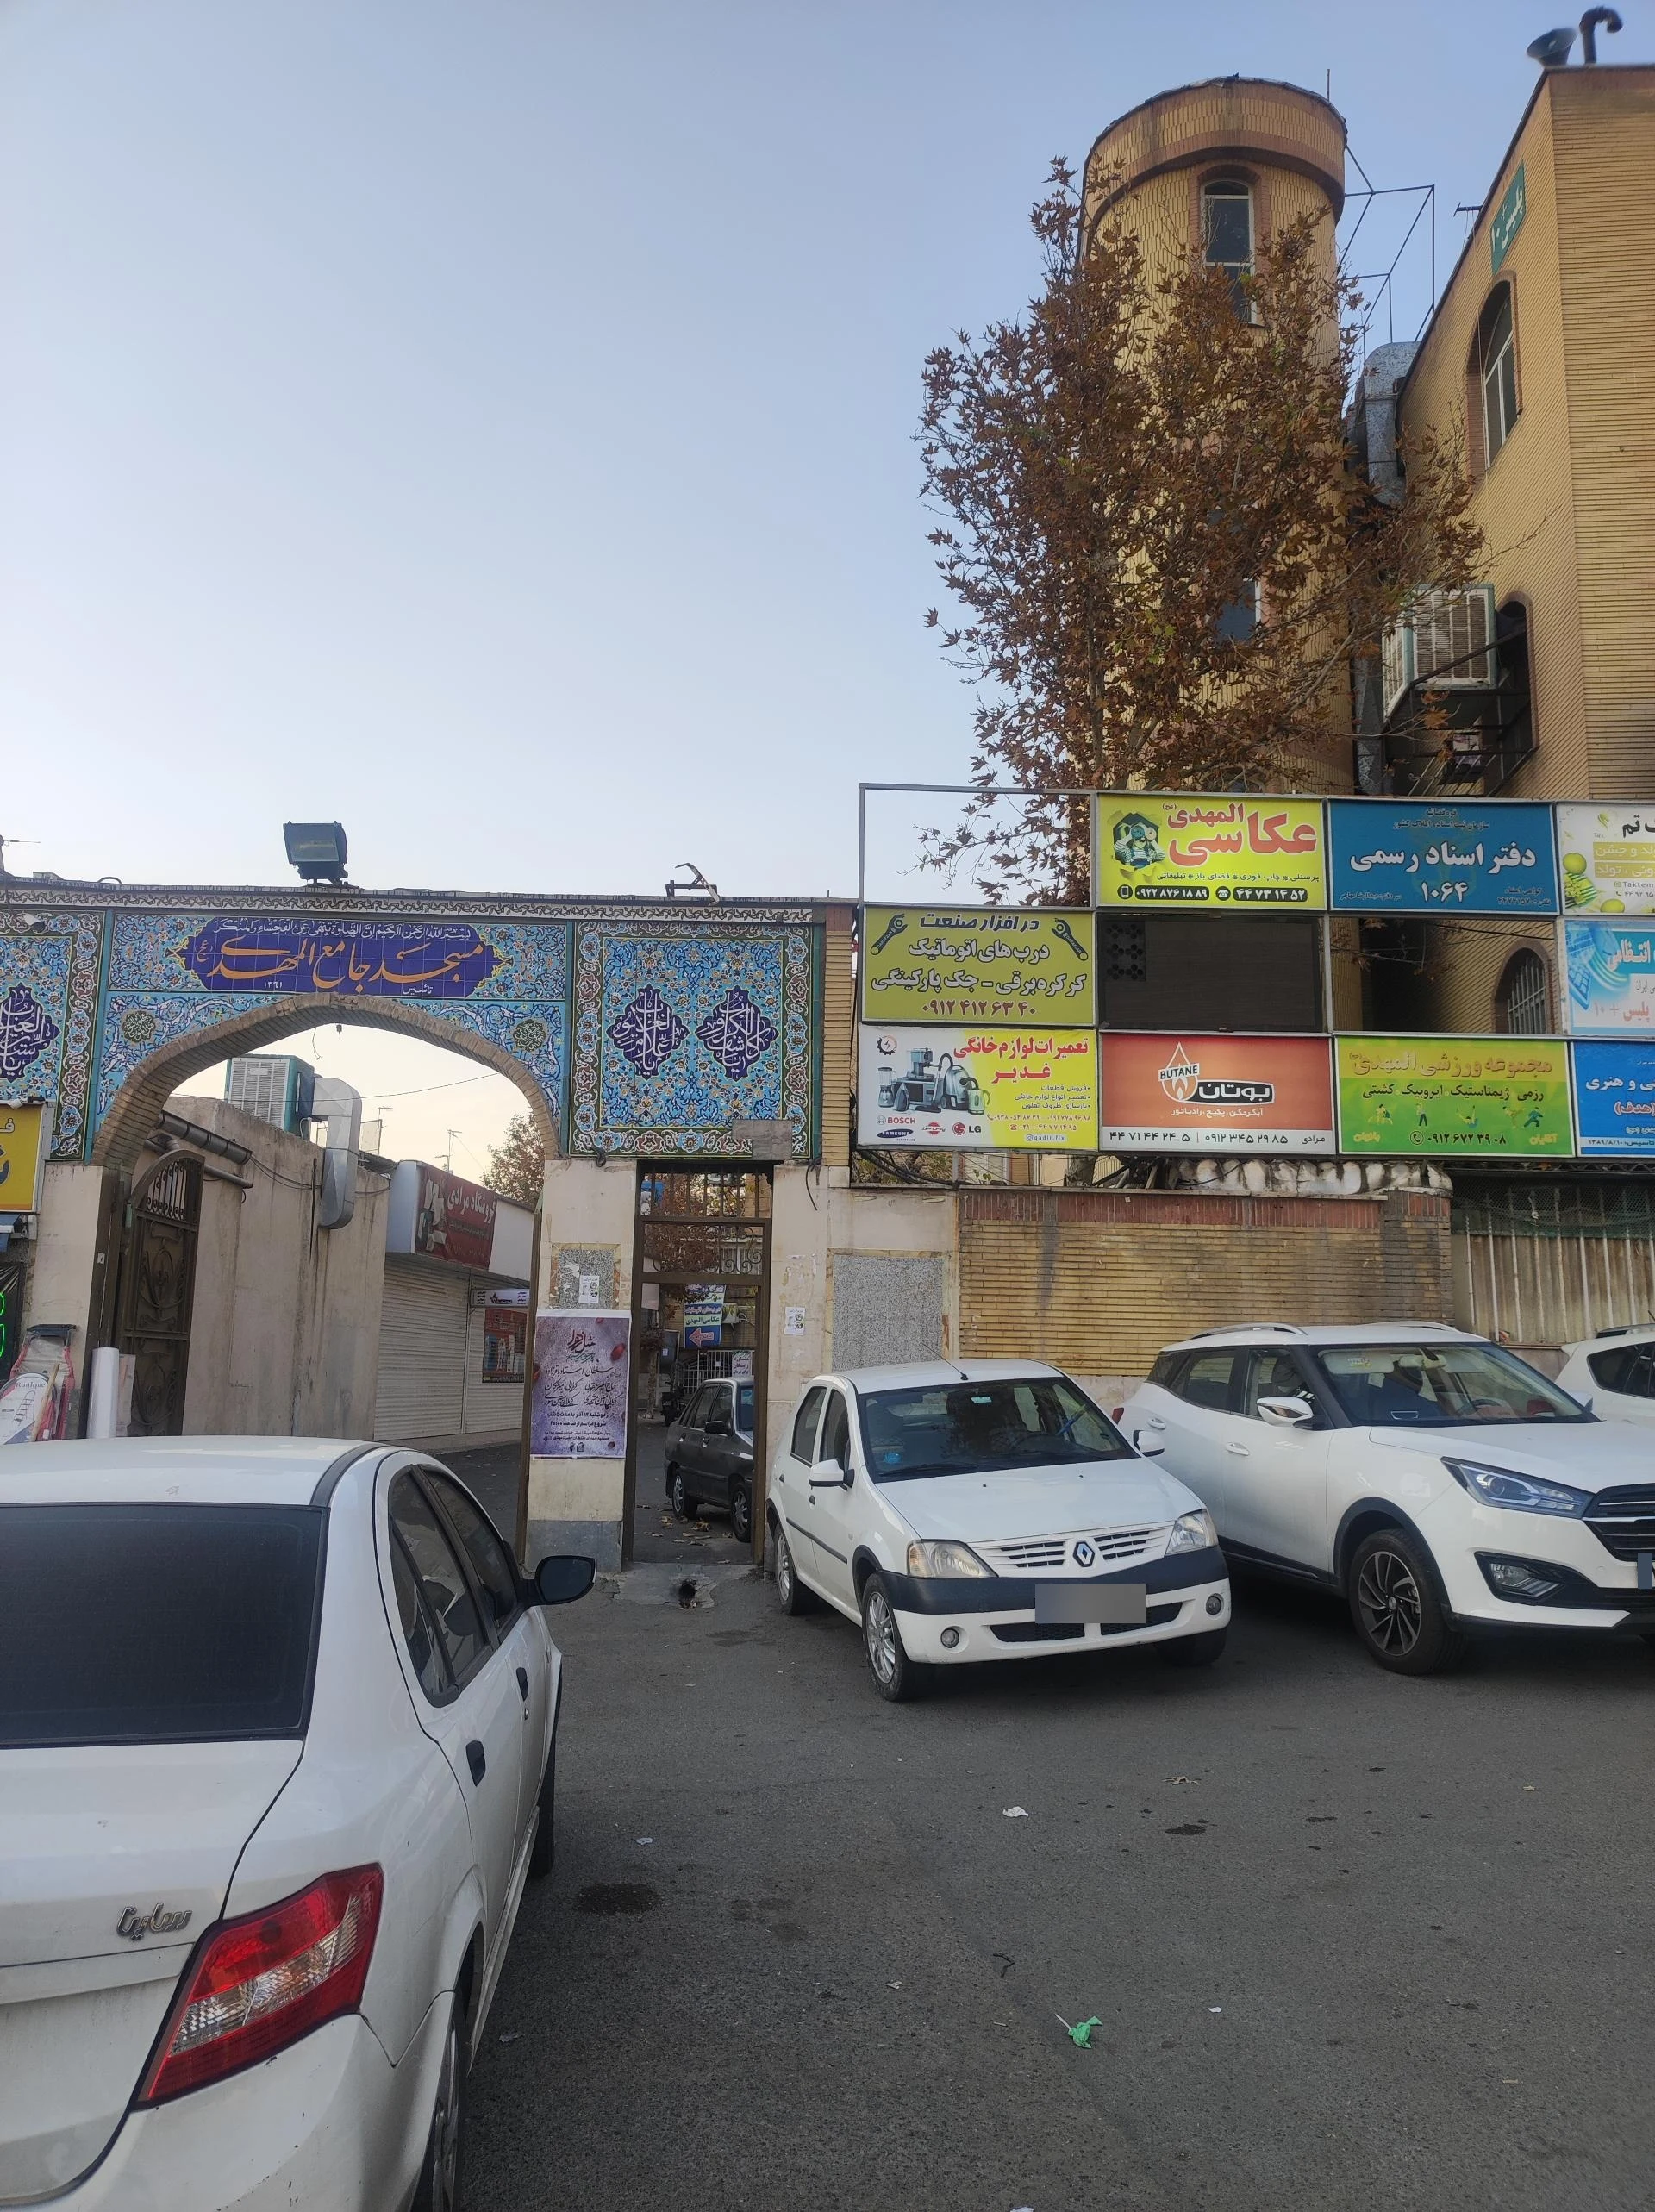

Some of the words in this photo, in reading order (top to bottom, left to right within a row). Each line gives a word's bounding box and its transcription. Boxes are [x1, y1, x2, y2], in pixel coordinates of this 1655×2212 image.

[1502, 186, 1523, 249] پلیس
[1167, 803, 1245, 829] المهدی
[1168, 810, 1318, 867] عکاسی
[1350, 848, 1420, 872] رسمی
[1426, 841, 1484, 866] اسناد
[1487, 840, 1537, 874] دفتر
[1158, 872, 1186, 881] تبلیغاتی
[1421, 881, 1469, 903] ۱۰۶۴
[920, 913, 977, 930] صنعت
[909, 938, 977, 961] اتوماتیک
[313, 940, 371, 994] جامع
[368, 942, 484, 984] مسجد
[872, 968, 941, 992] پارکینگی
[945, 971, 978, 992] جک
[1623, 1002, 1651, 1022] پلیس
[954, 1035, 998, 1059] خانگی
[998, 1036, 1034, 1059] لوازم
[1034, 1036, 1089, 1059] تعمیرات
[992, 1062, 1051, 1084] غدیر
[1160, 1065, 1199, 1080] BUTANE
[1421, 1053, 1483, 1078] ورزشی
[1485, 1056, 1552, 1078] مجموعه
[1199, 1084, 1271, 1102] بوتان
[1363, 1084, 1395, 1099] کشتی
[1401, 1084, 1443, 1099] ایروبیک
[1450, 1084, 1509, 1101] ژیمناستیک
[1586, 1076, 1624, 1090] هنری
[1517, 1087, 1544, 1102] رزمی
[1171, 1108, 1202, 1116] رادیاتور
[969, 1125, 982, 1134] LG
[1301, 1135, 1326, 1146] مرادی
[447, 1185, 469, 1215] مرادی
